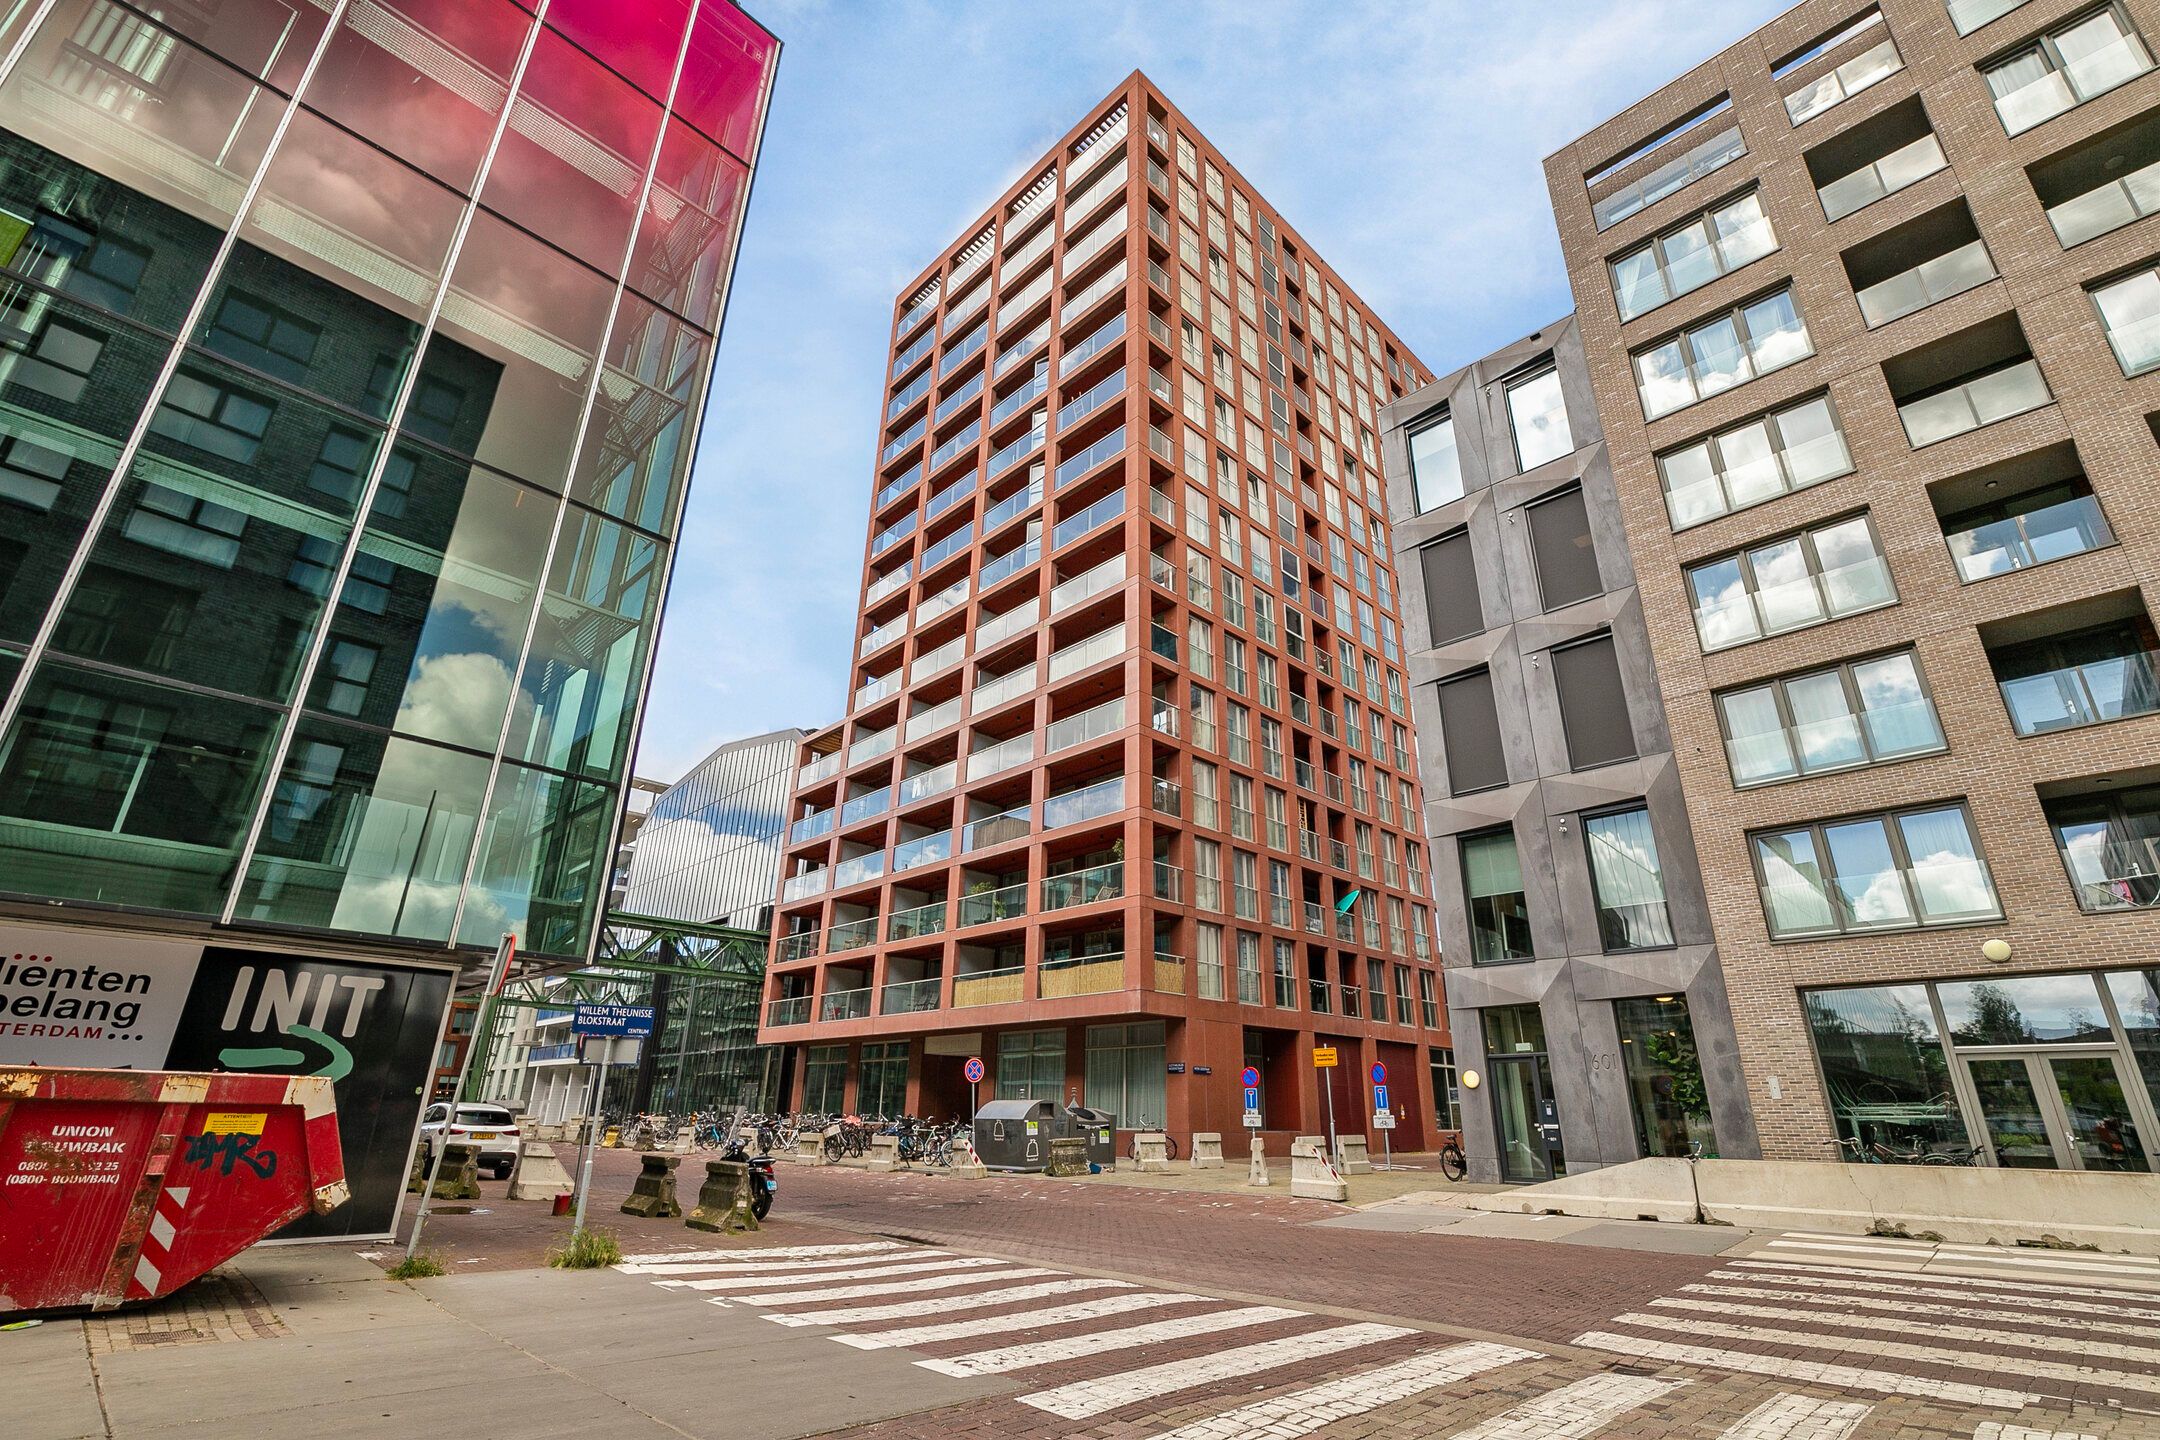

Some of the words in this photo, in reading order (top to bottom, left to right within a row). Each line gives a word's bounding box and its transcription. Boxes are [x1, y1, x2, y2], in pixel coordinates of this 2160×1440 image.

[221, 966, 385, 1038] INIT
[0, 991, 141, 1029] elang
[579, 1005, 609, 1016] WILLEM
[612, 1007, 653, 1018] THEUNISSE
[577, 1015, 627, 1026] BLOKSTRAAT
[1591, 1053, 1617, 1070] 601
[52, 1125, 114, 1137] UNION
[103, 1162, 119, 1171] 25
